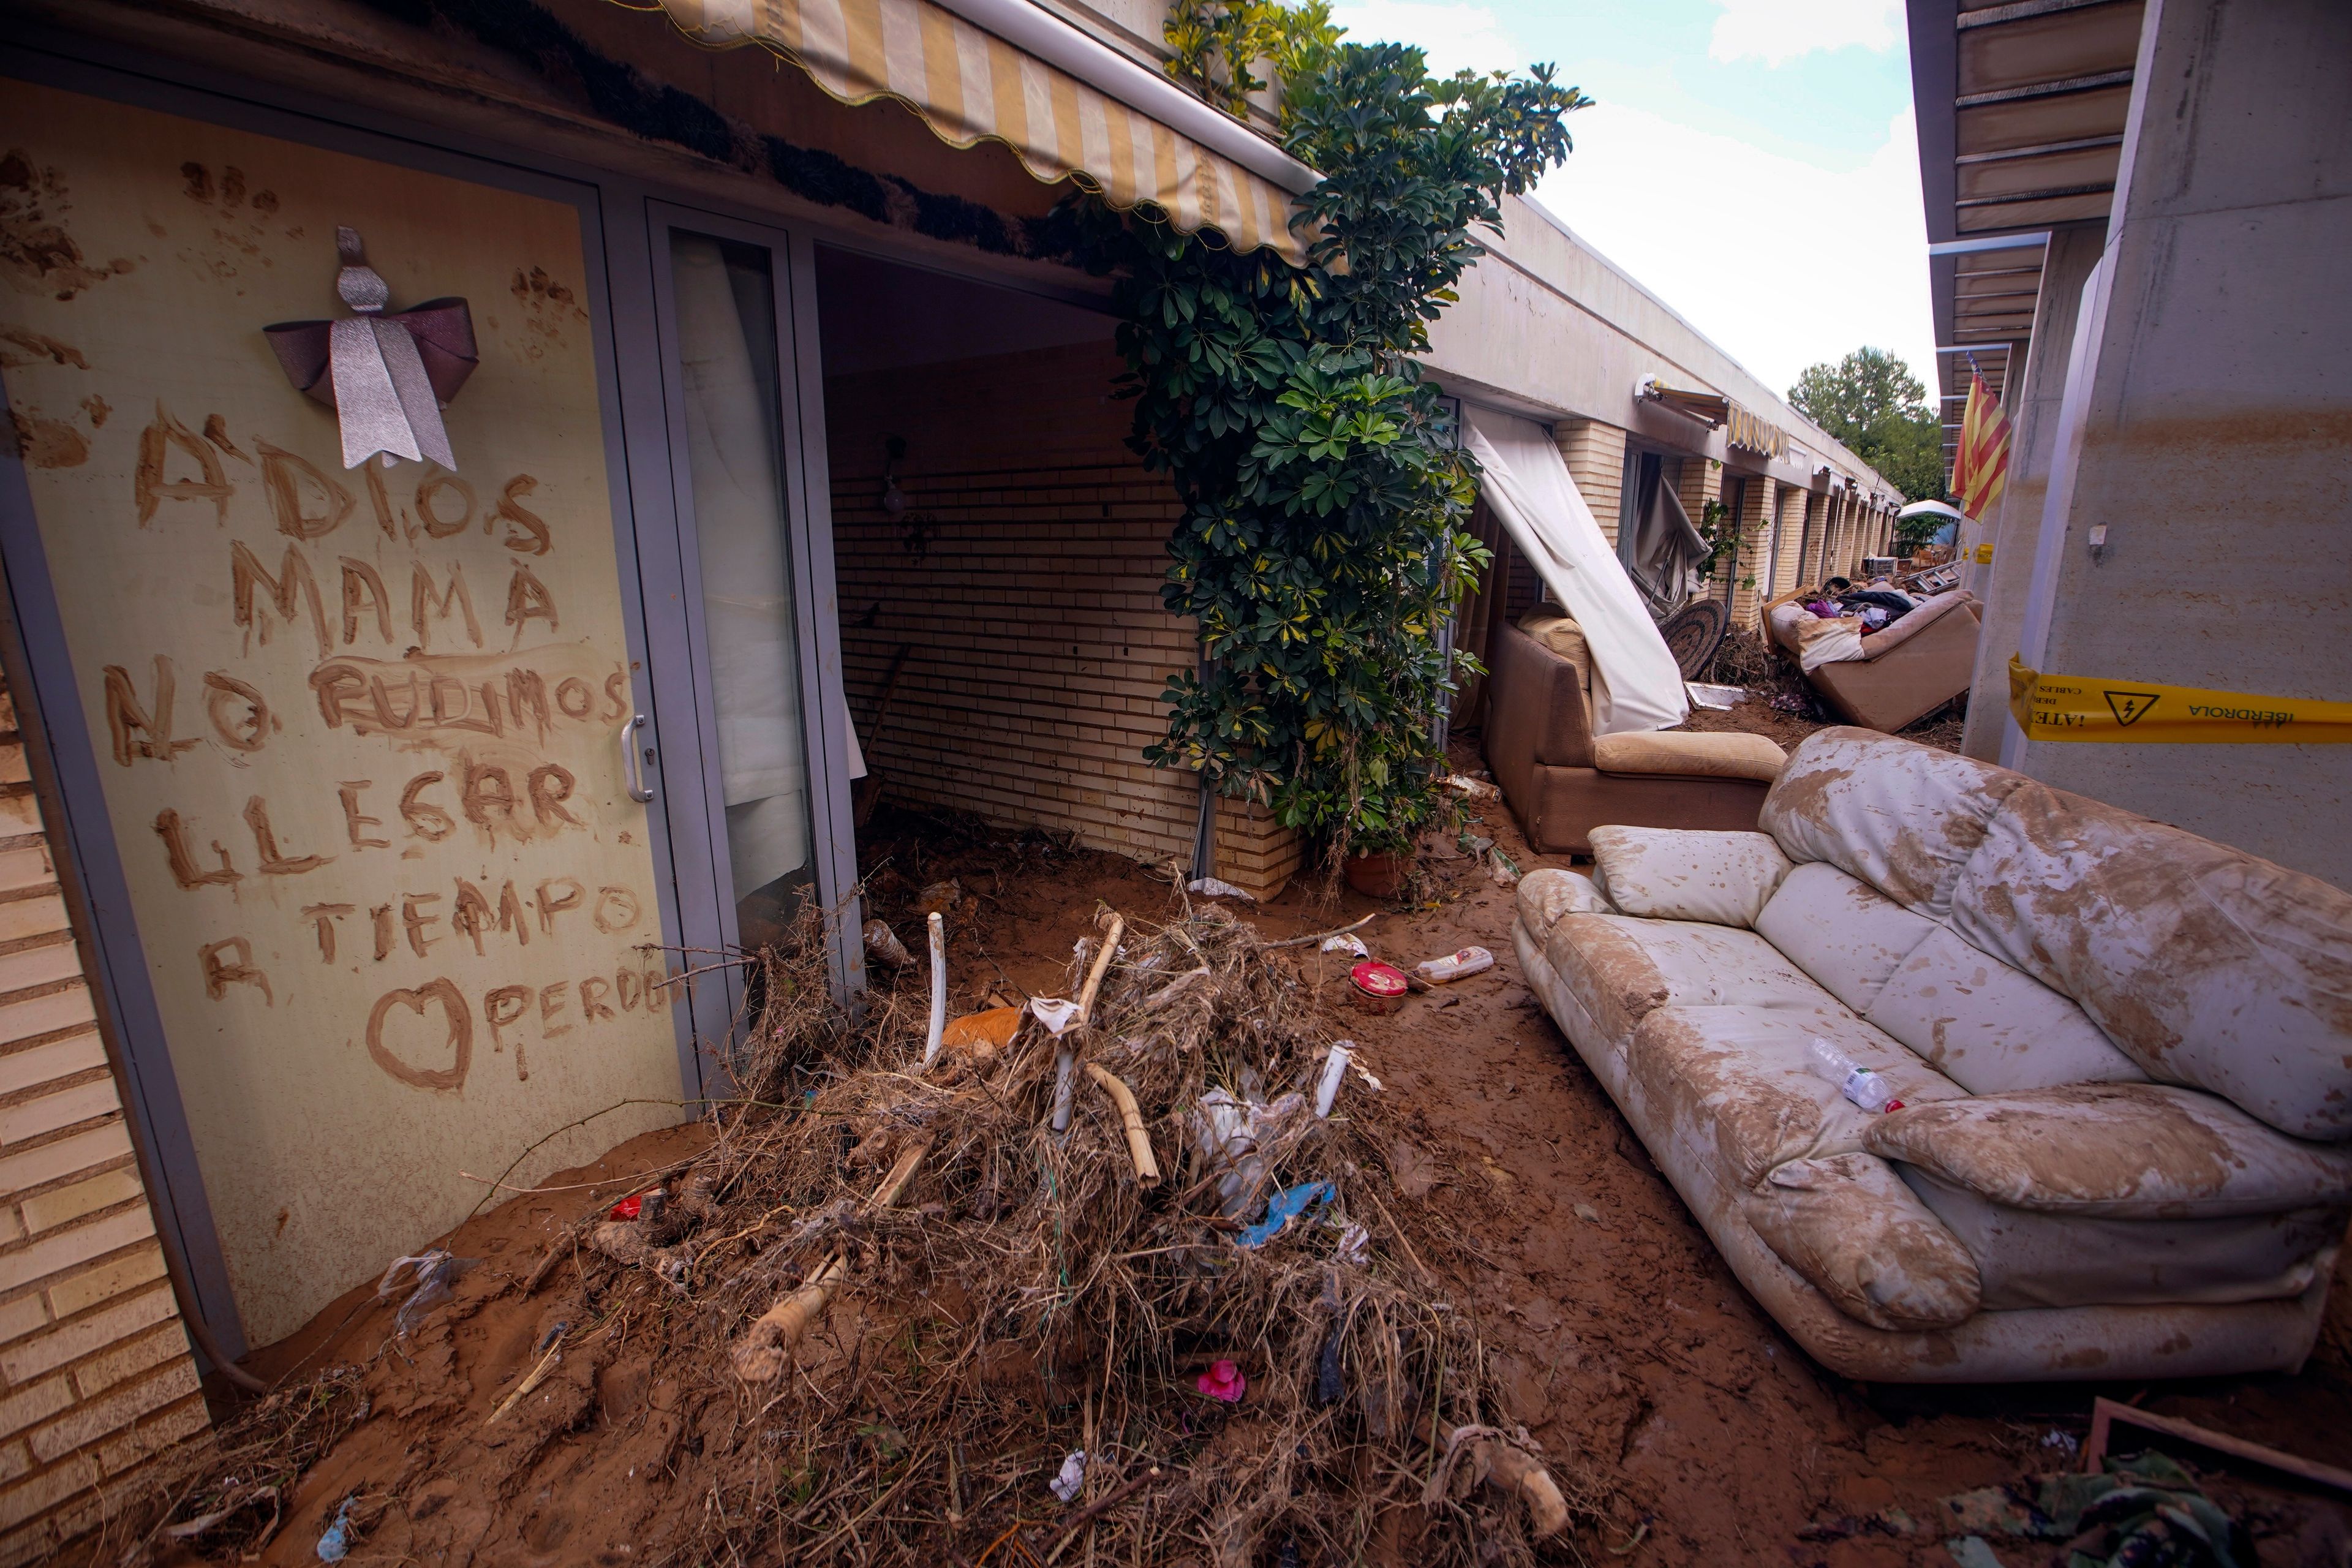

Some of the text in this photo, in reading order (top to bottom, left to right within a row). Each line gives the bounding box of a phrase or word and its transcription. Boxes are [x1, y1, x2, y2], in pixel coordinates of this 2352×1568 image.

[103, 654, 628, 768] NO PUDIMOS
[2031, 711, 2085, 727] ¡ATE
[2039, 686, 2082, 695] CABLES
[2188, 705, 2294, 723] IBERDROLA
[156, 762, 587, 892] LLEGAR
[197, 876, 641, 1007] A TIEMPO
